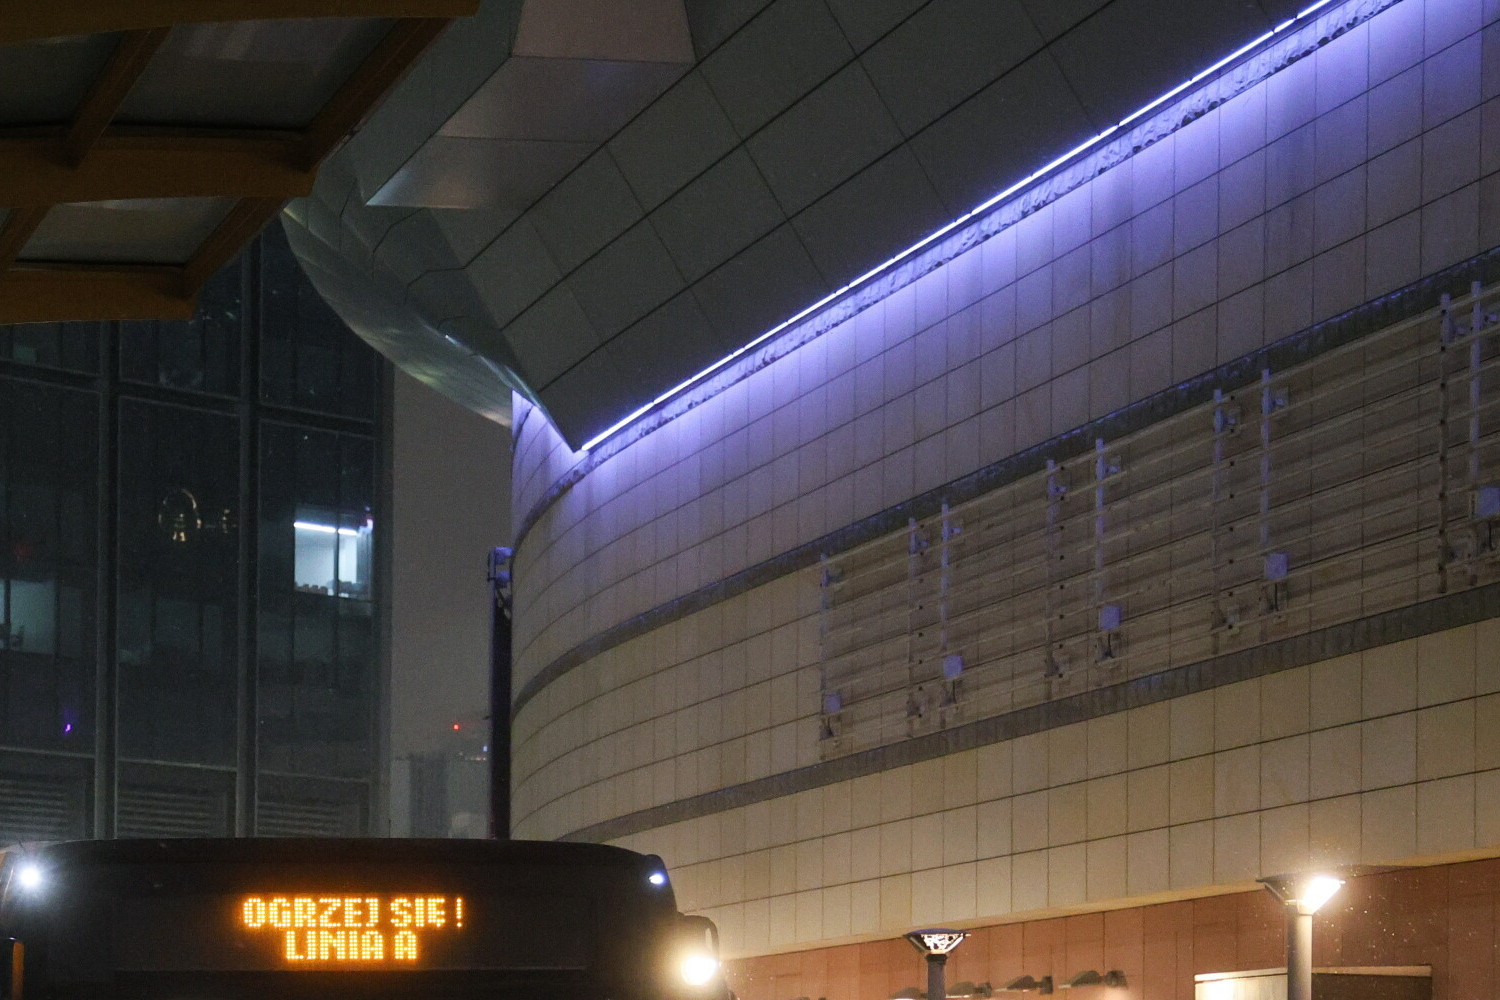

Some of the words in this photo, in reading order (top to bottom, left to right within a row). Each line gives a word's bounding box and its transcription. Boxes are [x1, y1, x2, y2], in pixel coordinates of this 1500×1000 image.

[243, 898, 379, 927] OGRZEJ
[285, 930, 383, 960] LINIA
[394, 930, 417, 960] A
